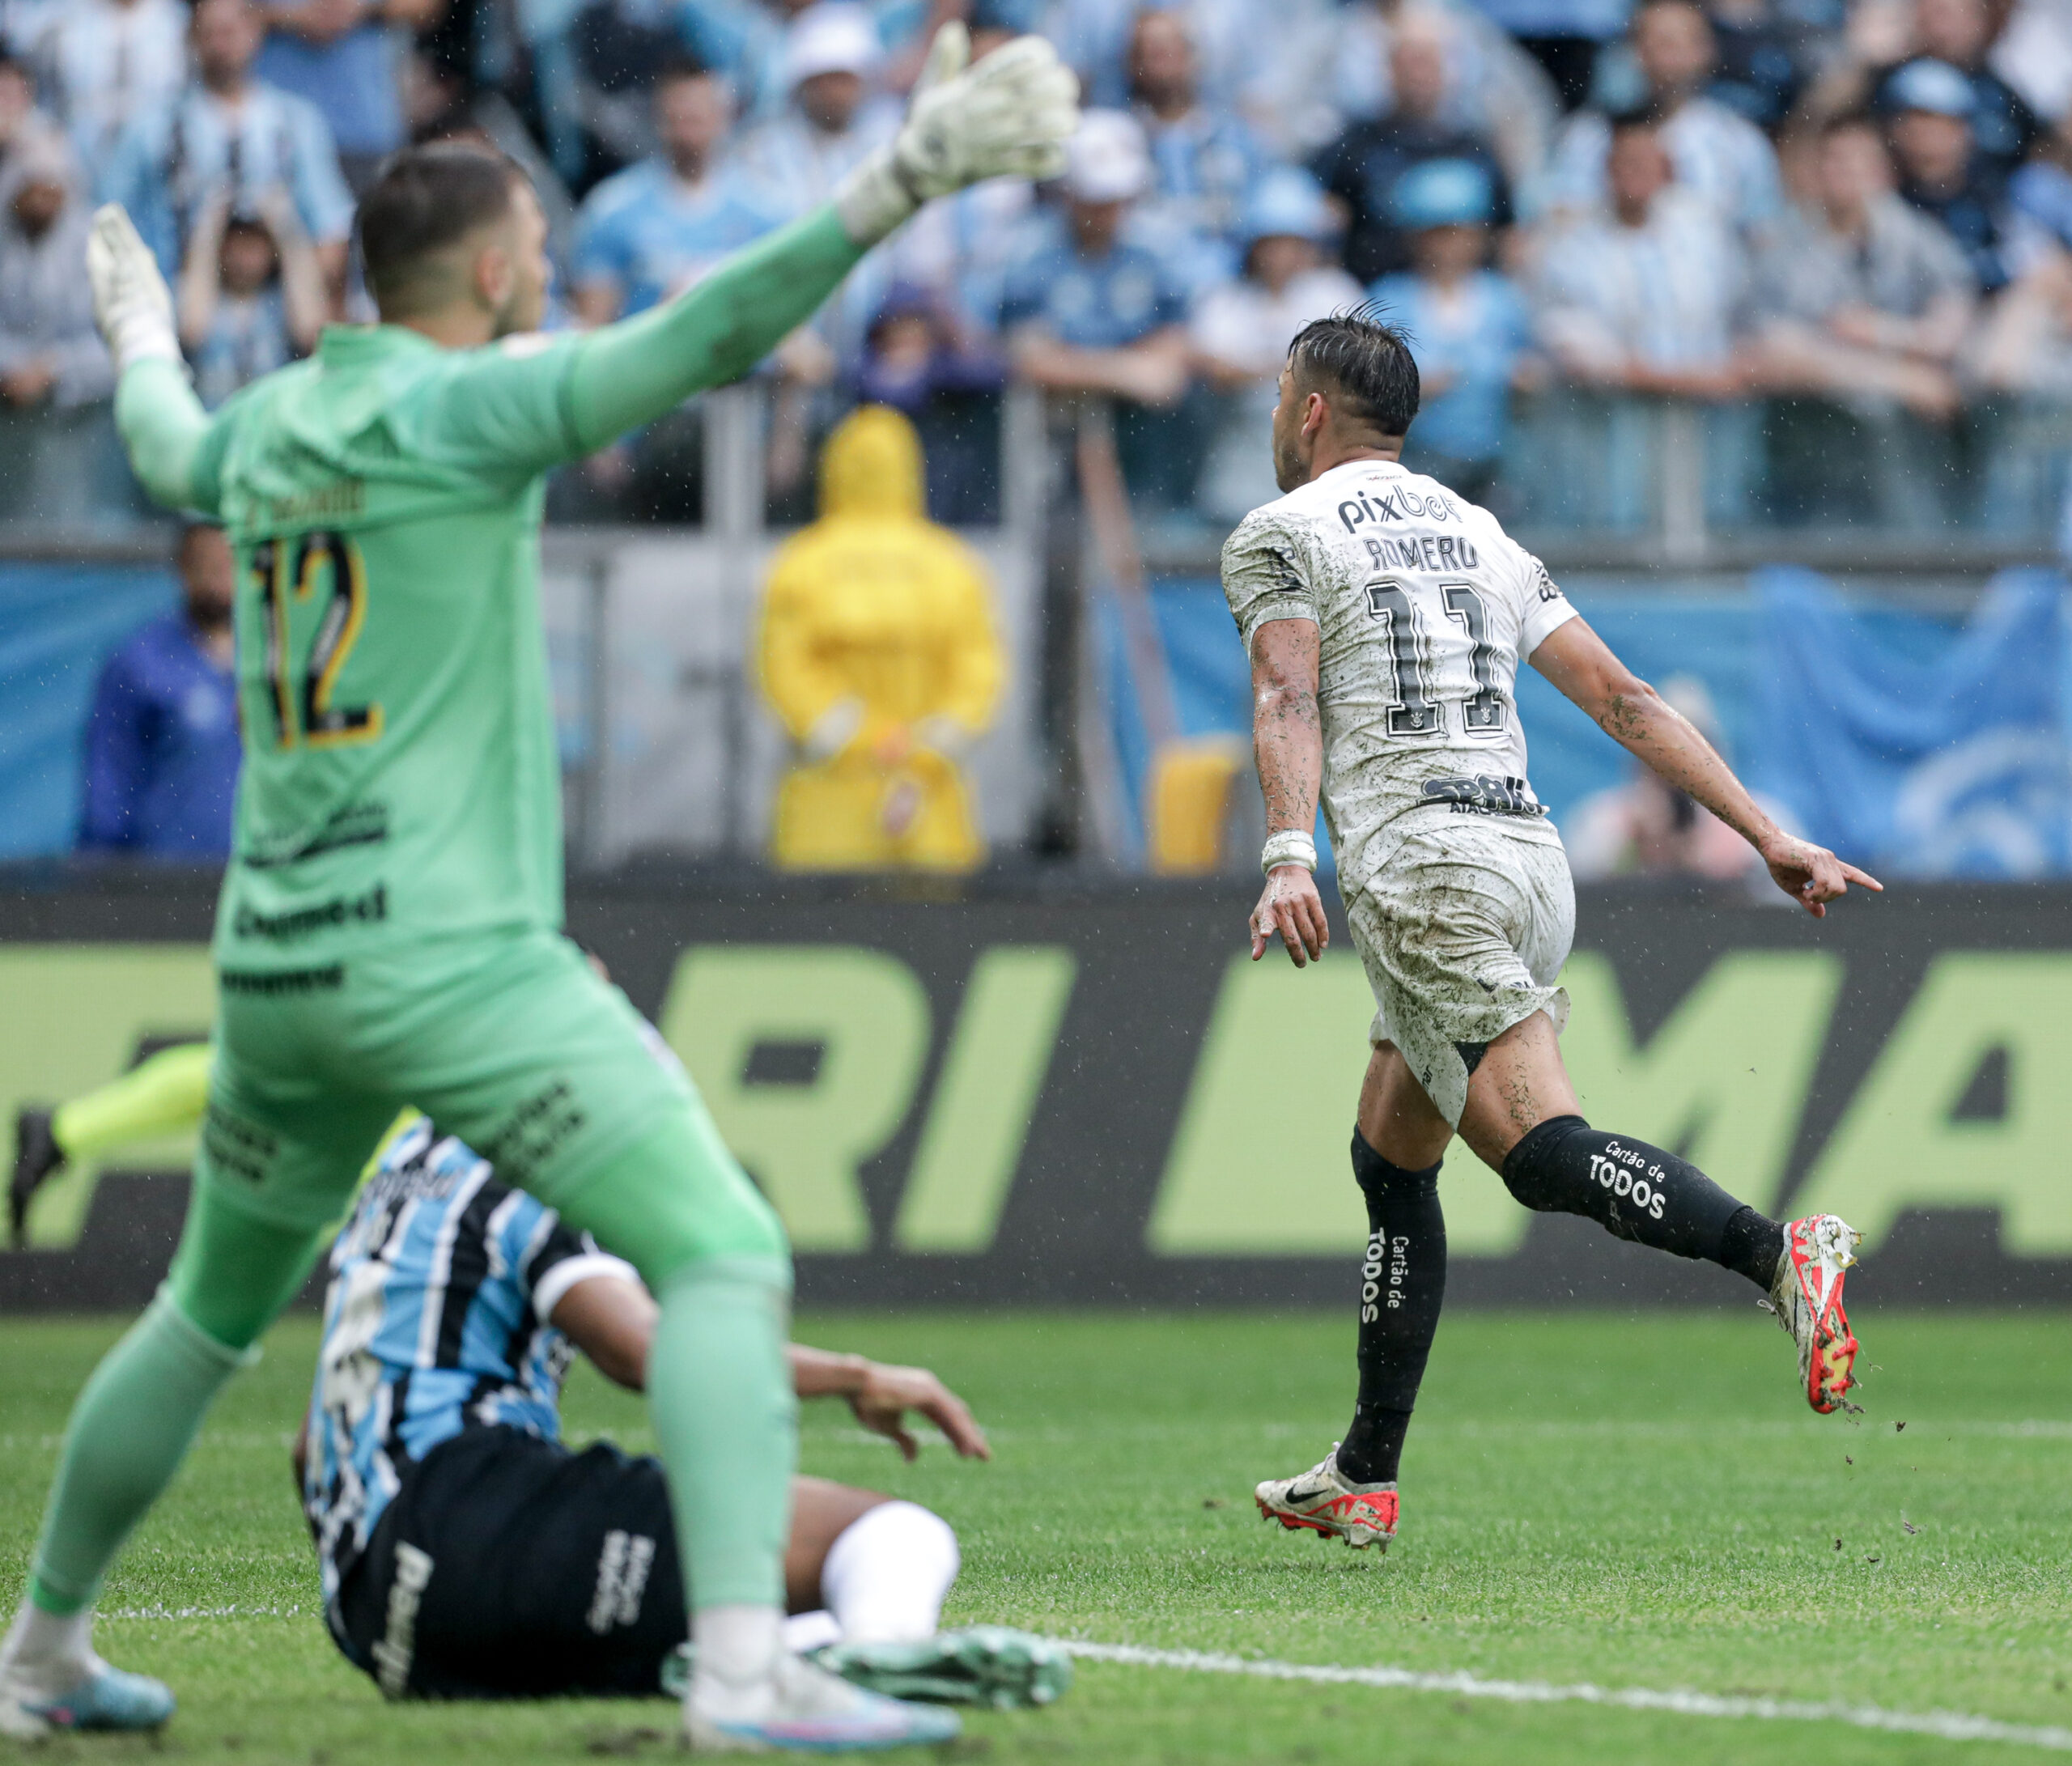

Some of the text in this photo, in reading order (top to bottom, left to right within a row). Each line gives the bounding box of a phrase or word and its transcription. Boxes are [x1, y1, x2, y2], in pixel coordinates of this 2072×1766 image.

[1338, 484, 1463, 534] pixbet
[1363, 535, 1480, 571] ROMERO
[253, 530, 387, 751] 12
[1365, 580, 1511, 740] 11
[1590, 1154, 1667, 1219] TODOS
[1605, 1140, 1666, 1182] Cartão de
[1361, 1226, 1386, 1324] TODOS
[1387, 1236, 1410, 1309] Cartão de
